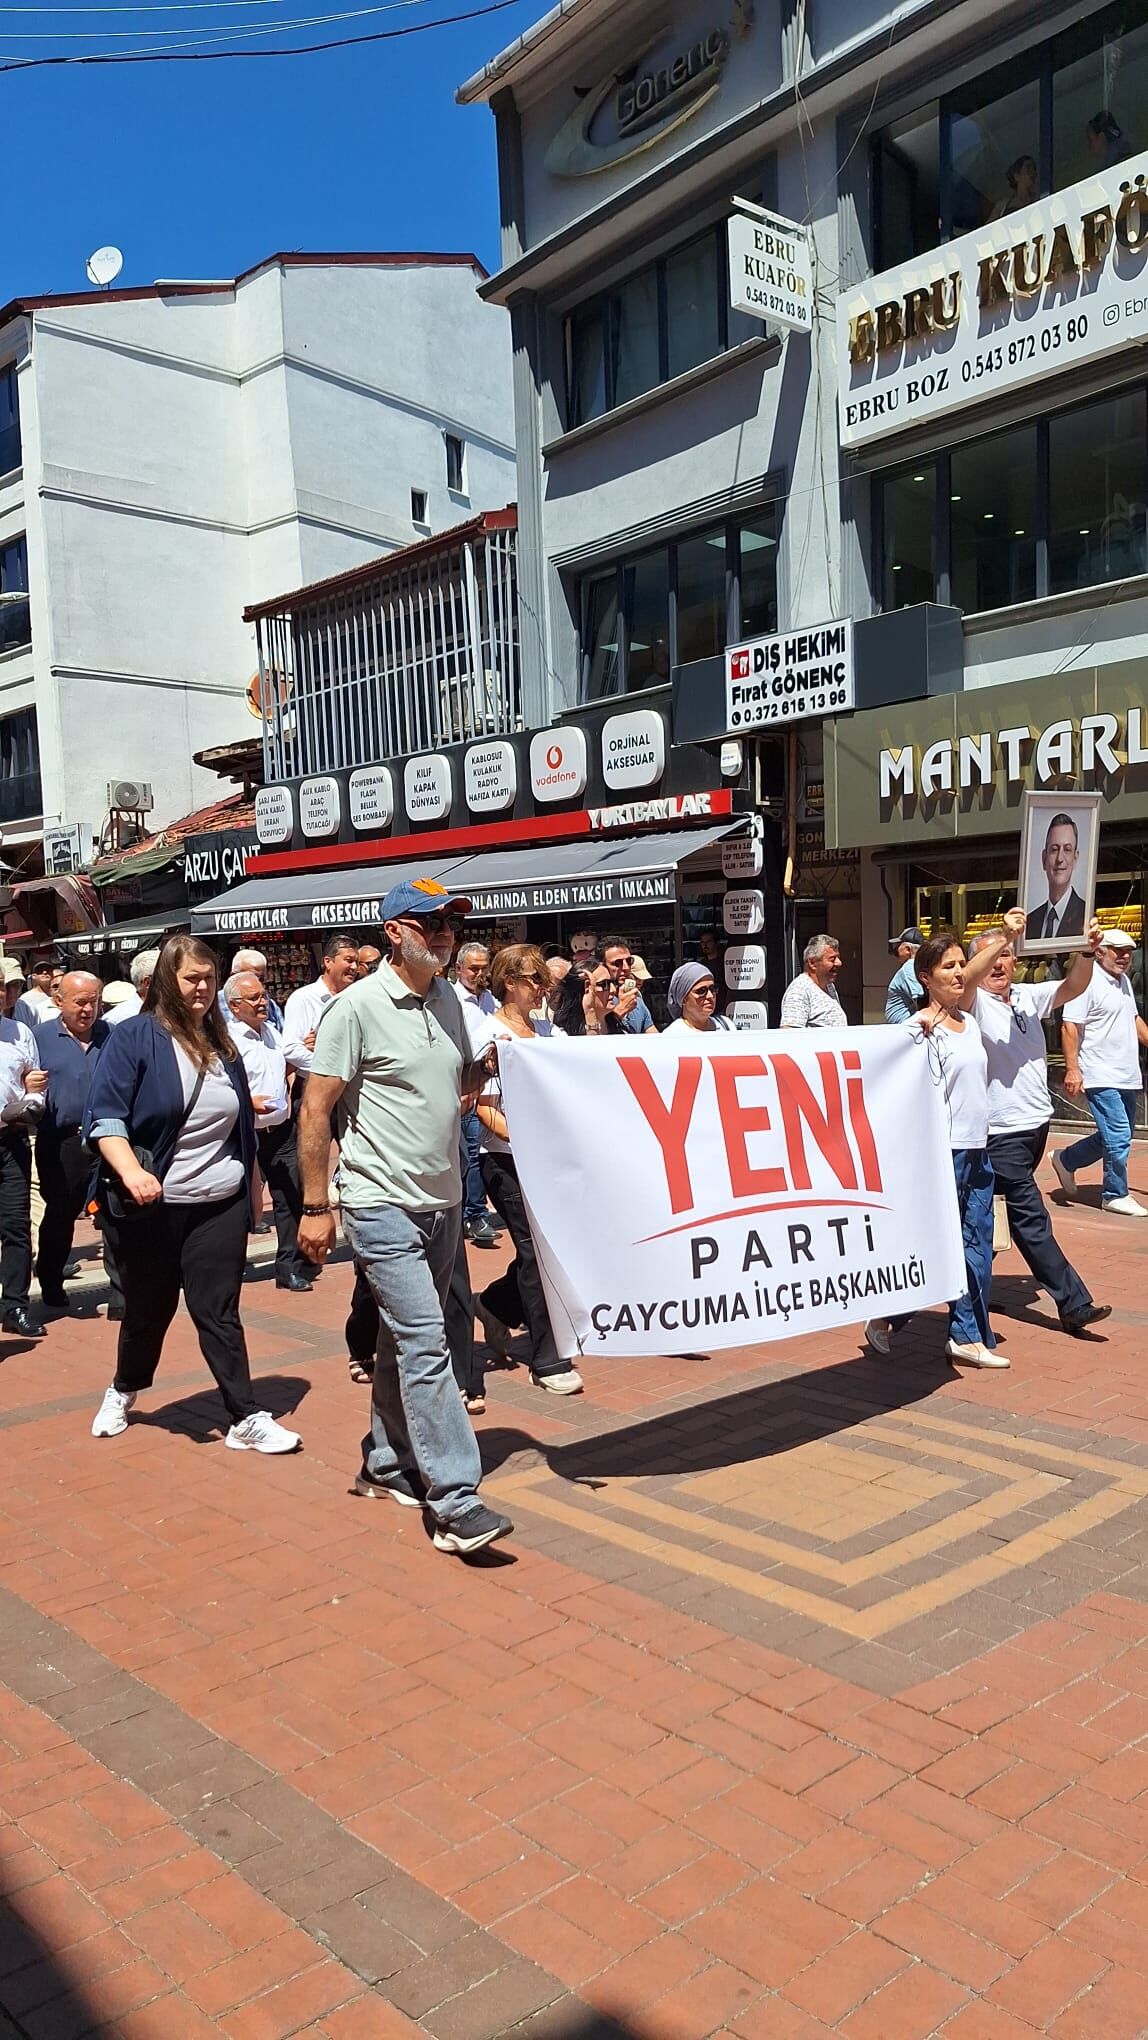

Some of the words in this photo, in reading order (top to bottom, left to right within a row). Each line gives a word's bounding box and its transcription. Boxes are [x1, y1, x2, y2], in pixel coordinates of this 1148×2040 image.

[753, 229, 795, 264] EBRU
[744, 254, 806, 298] KUAFÖR
[746, 285, 768, 307] 0.543
[769, 295, 784, 313] 872
[786, 301, 796, 317] 03
[797, 305, 806, 321] 80
[848, 270, 960, 364] EBRU
[845, 388, 899, 426] EBRU
[906, 368, 949, 403] BOZ
[961, 347, 1003, 383] 0.543
[1008, 334, 1035, 365] 872
[1041, 324, 1061, 352] 03
[1067, 315, 1088, 343] 80
[731, 680, 768, 706] Fırat
[772, 662, 846, 697] GÖNENÇ
[744, 703, 778, 723] 0.372
[810, 693, 825, 710] 13
[609, 733, 651, 752] ORJİNAL
[471, 751, 503, 765] KABLOSUZ
[880, 707, 1148, 798] MANTARL
[606, 751, 655, 772] AKSESUAR
[416, 767, 432, 779] KILIF
[473, 764, 502, 777] KULAKLIK
[351, 775, 384, 789] POWERBANK
[477, 777, 499, 789] RADYO
[536, 771, 576, 787] vodafone
[314, 783, 331, 794] KABLO
[360, 789, 376, 799] FLASH
[413, 781, 436, 794] KAPAK
[468, 790, 490, 802] HAFIZA
[491, 787, 509, 798] KARTI
[807, 785, 824, 797] EBR
[310, 797, 325, 808] ARAÇ
[360, 799, 378, 811] BELLEK
[411, 795, 441, 809] DÜNYASI
[257, 807, 269, 817] DATA
[269, 804, 286, 814] KABLO
[307, 808, 328, 818] TELEFON
[352, 813, 362, 823] SES
[362, 810, 387, 822] BOMBASI
[588, 793, 712, 829] YURTBAYLAR
[184, 849, 219, 883] ARZU
[214, 908, 288, 932] YURTBAYLAR
[311, 901, 381, 925] AKSESUAR
[468, 891, 528, 911] NLARINDA
[533, 887, 569, 906] ELDEN
[572, 880, 614, 903] TAKSİT
[619, 877, 669, 899] İMKANI
[590, 1291, 750, 1340] ÇAYCUMA
[754, 1279, 804, 1322] İLÇE
[809, 1255, 926, 1309] BAŞKANLIĞI
